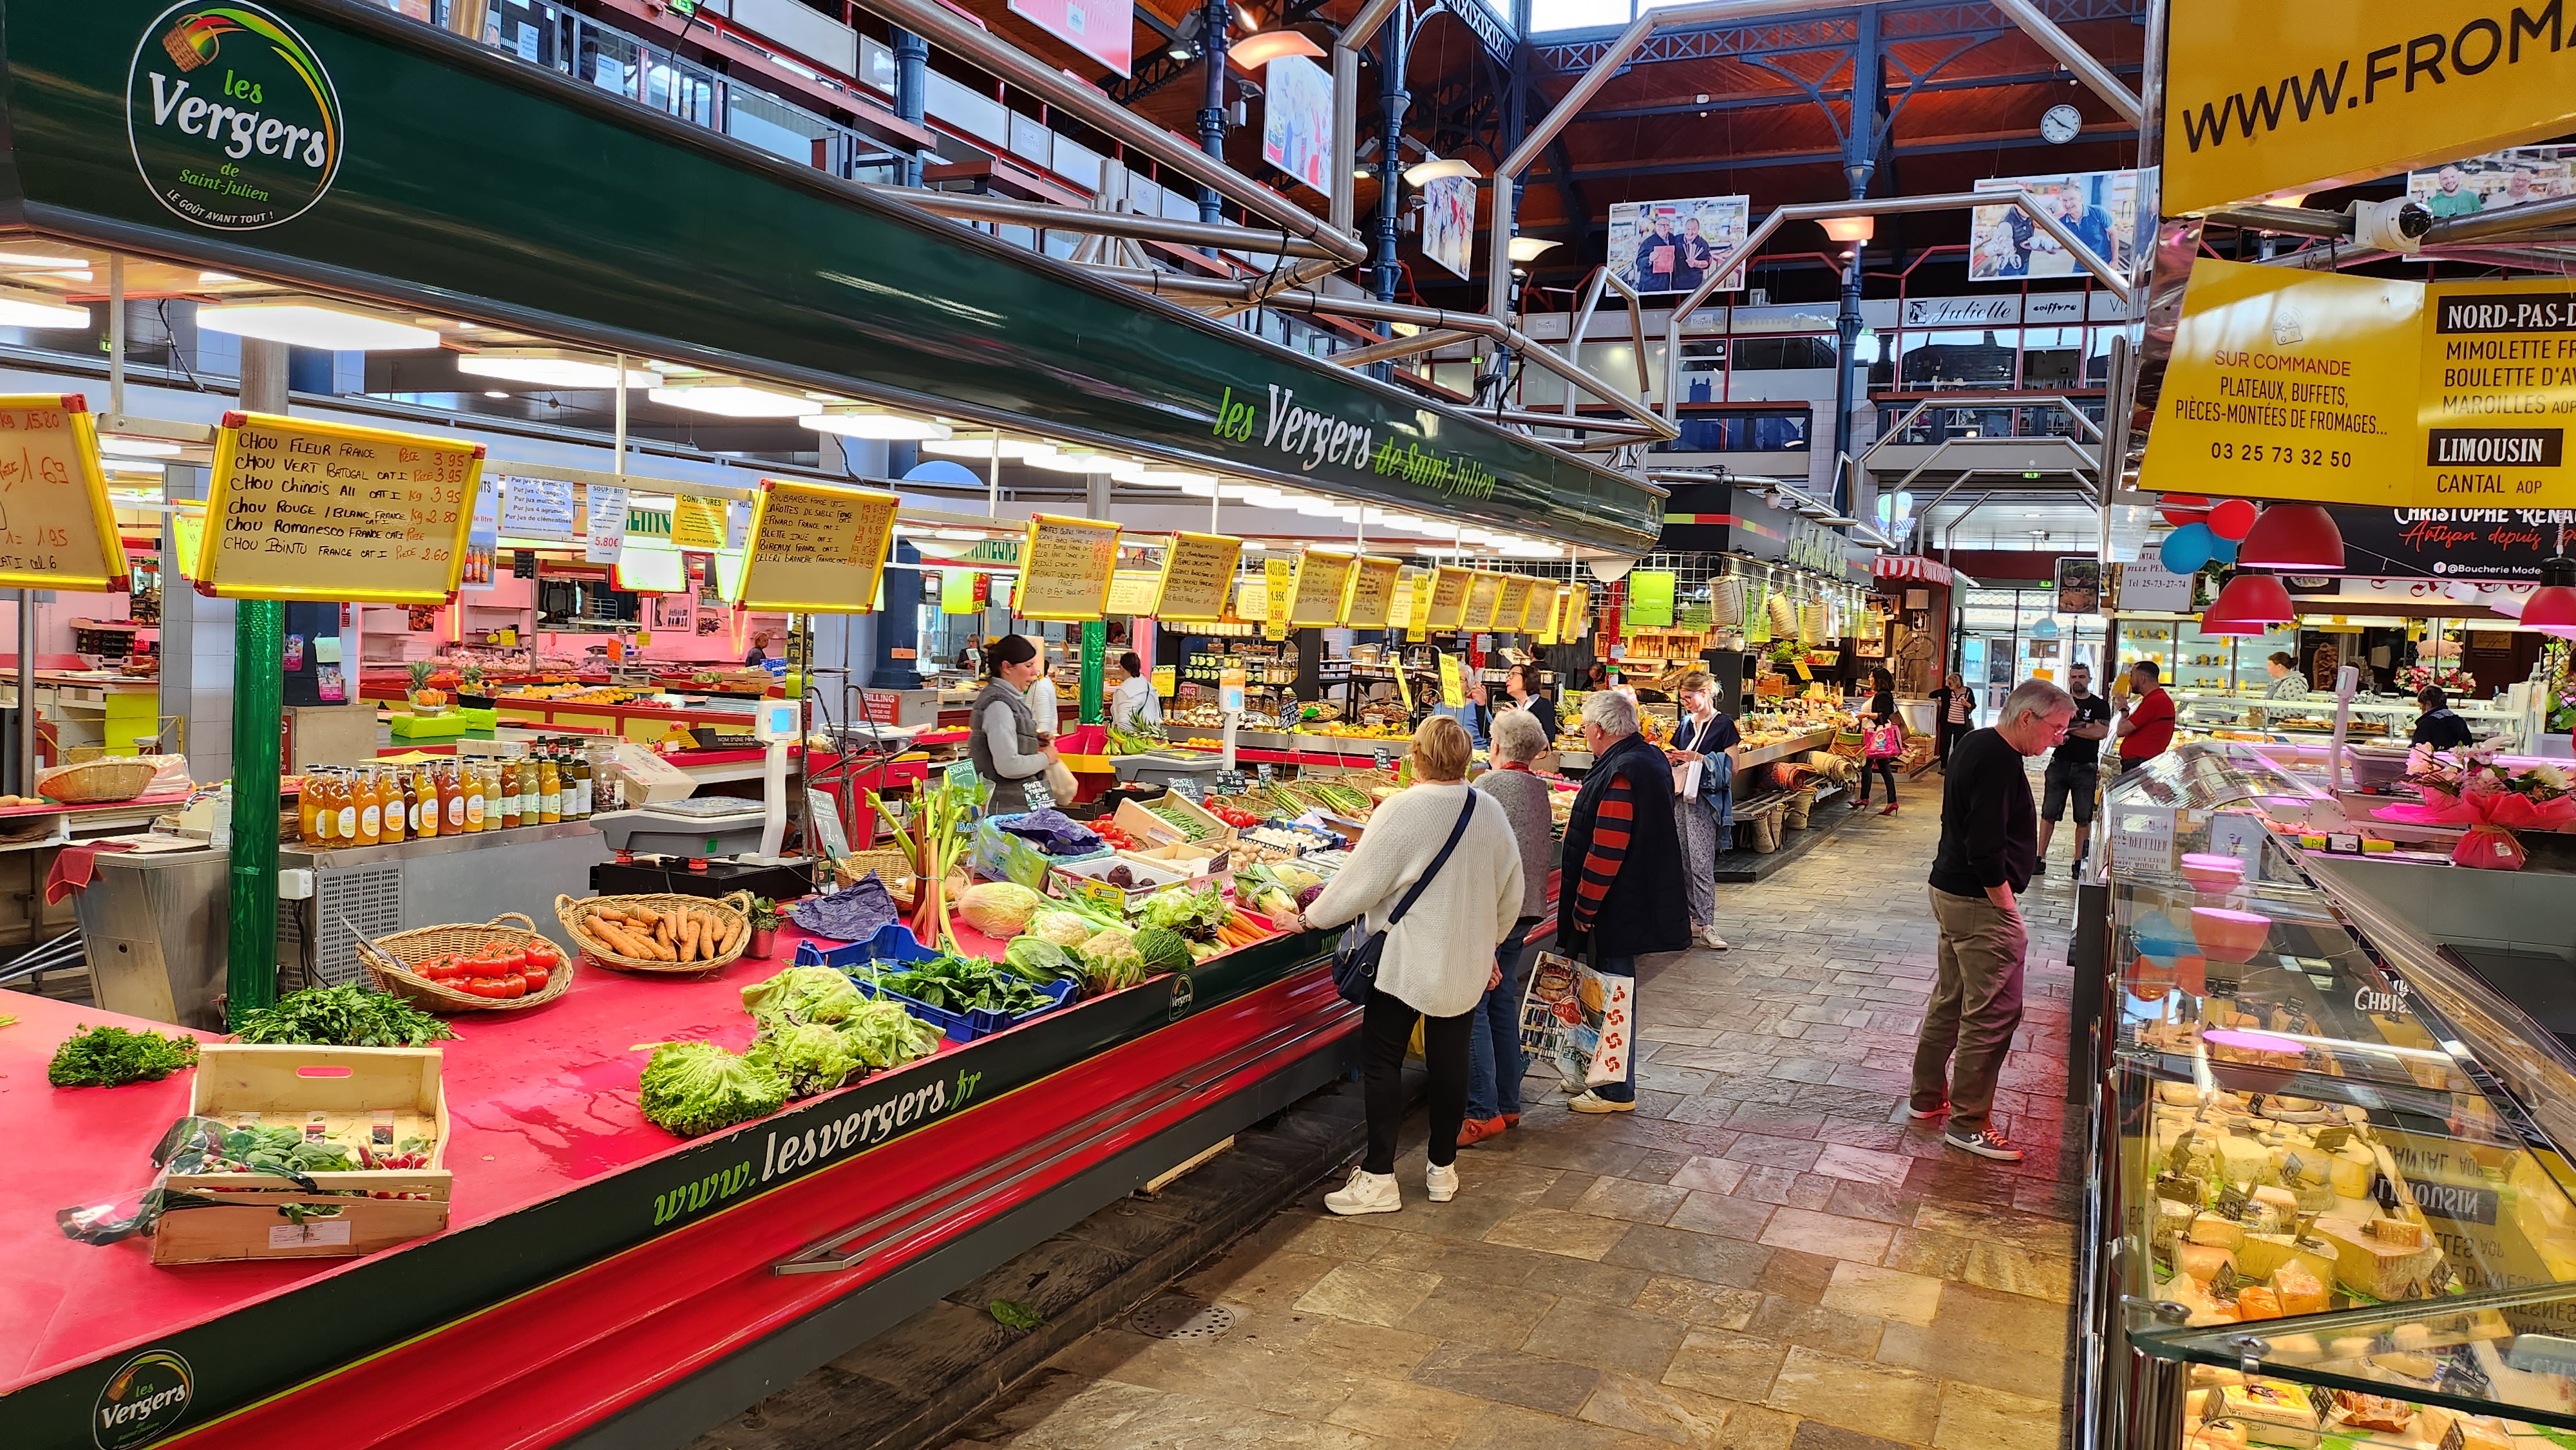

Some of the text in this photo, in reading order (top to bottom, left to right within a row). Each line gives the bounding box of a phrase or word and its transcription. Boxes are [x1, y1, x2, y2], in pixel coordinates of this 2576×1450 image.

[224, 69, 263, 104] les
[2183, 0, 2576, 153] WWW.FROM
[149, 71, 325, 167] Vergers
[220, 163, 240, 177] de
[179, 169, 269, 202] Saint-Julien
[166, 189, 178, 203] LE
[178, 204, 205, 218] GOÛT
[205, 212, 236, 224] AVANT
[240, 213, 267, 224] TOUT
[1692, 317, 1711, 326] Troyes
[1932, 299, 2012, 323] Juliette
[2447, 340, 2551, 360] MIMOLETTE
[2215, 350, 2351, 377] SUR COMMANDE
[2445, 367, 2535, 387] BOULETTE
[2221, 376, 2349, 408] PLATEAUX, BUFFETS,
[2175, 396, 2388, 436] PIÈCES-MONTÉES DE FROMAGES...
[2443, 395, 2546, 414] MAROILLES
[1213, 386, 1254, 442] les
[1264, 383, 1372, 471] Vergers
[1374, 436, 1401, 475] de
[240, 432, 278, 449] CHOU
[290, 438, 331, 455] FLEUR
[433, 453, 465, 467] 3.95
[2211, 442, 2351, 468] 03 25 73 32 50
[2438, 437, 2544, 463] LIMOUSIN
[235, 453, 275, 471] CHOU
[284, 459, 321, 473] VERT
[327, 462, 368, 480] PORTUGAL
[434, 467, 462, 483] 3.95
[230, 474, 273, 491] CHOU
[430, 487, 461, 504] 3.95
[2437, 474, 2542, 494] CANTAL AOP
[276, 500, 317, 514] ROUGE
[426, 509, 457, 523] 2.80
[274, 519, 344, 537] Romanesco
[2399, 520, 2541, 552] Artisan depuis
[223, 536, 258, 551] CHOU
[319, 545, 352, 556] FRANCE
[595, 536, 619, 547] 5.80€
[2448, 564, 2509, 574] @Boucherie
[2142, 579, 2186, 588] 25-73-27-74
[1271, 590, 1285, 601] 1.95€
[1267, 626, 1283, 636] France
[864, 693, 895, 702] BILLING
[949, 762, 973, 775] ENDIVES
[135, 1383, 154, 1398] les
[101, 1384, 186, 1429] Vergers
